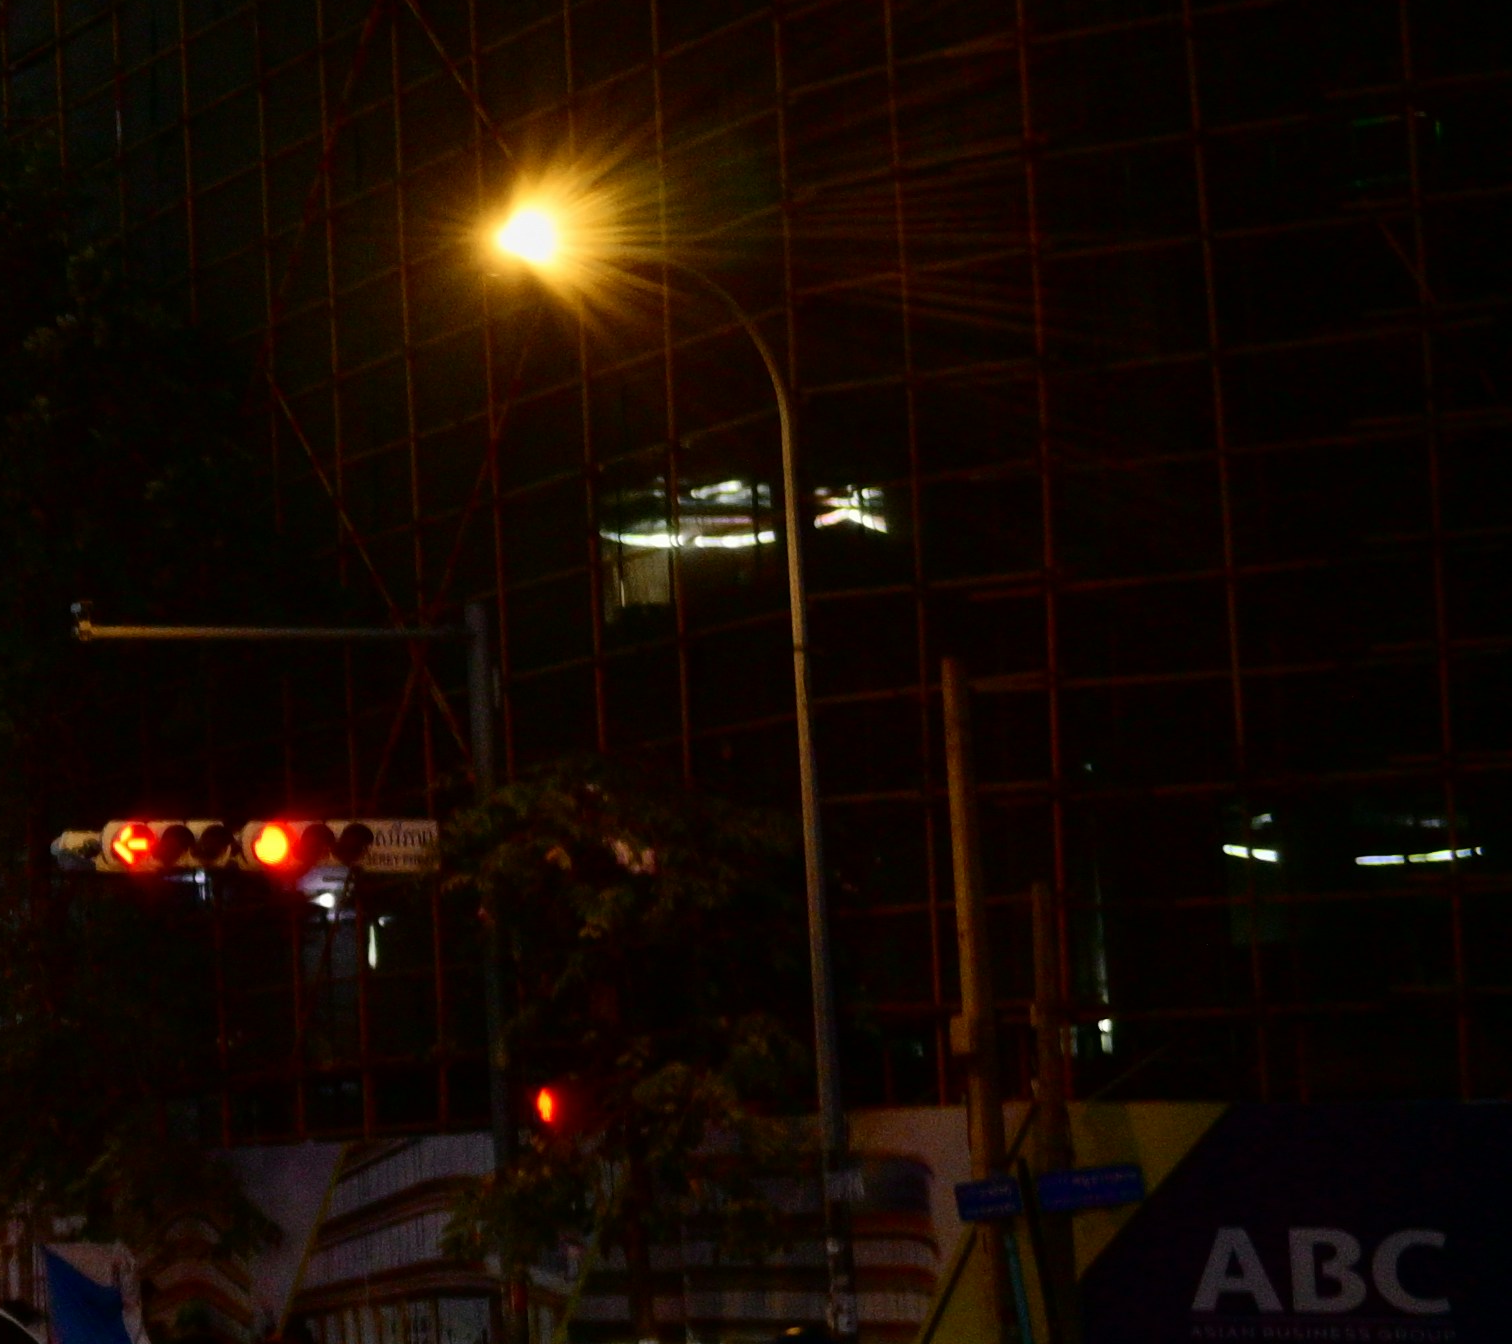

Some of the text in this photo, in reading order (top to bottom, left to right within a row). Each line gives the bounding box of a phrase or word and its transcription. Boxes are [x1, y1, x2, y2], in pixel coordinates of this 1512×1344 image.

[1190, 1225, 1452, 1315] ABC
[1190, 1324, 1257, 1341] ASIAN
[1262, 1324, 1371, 1343] BUSINESS
